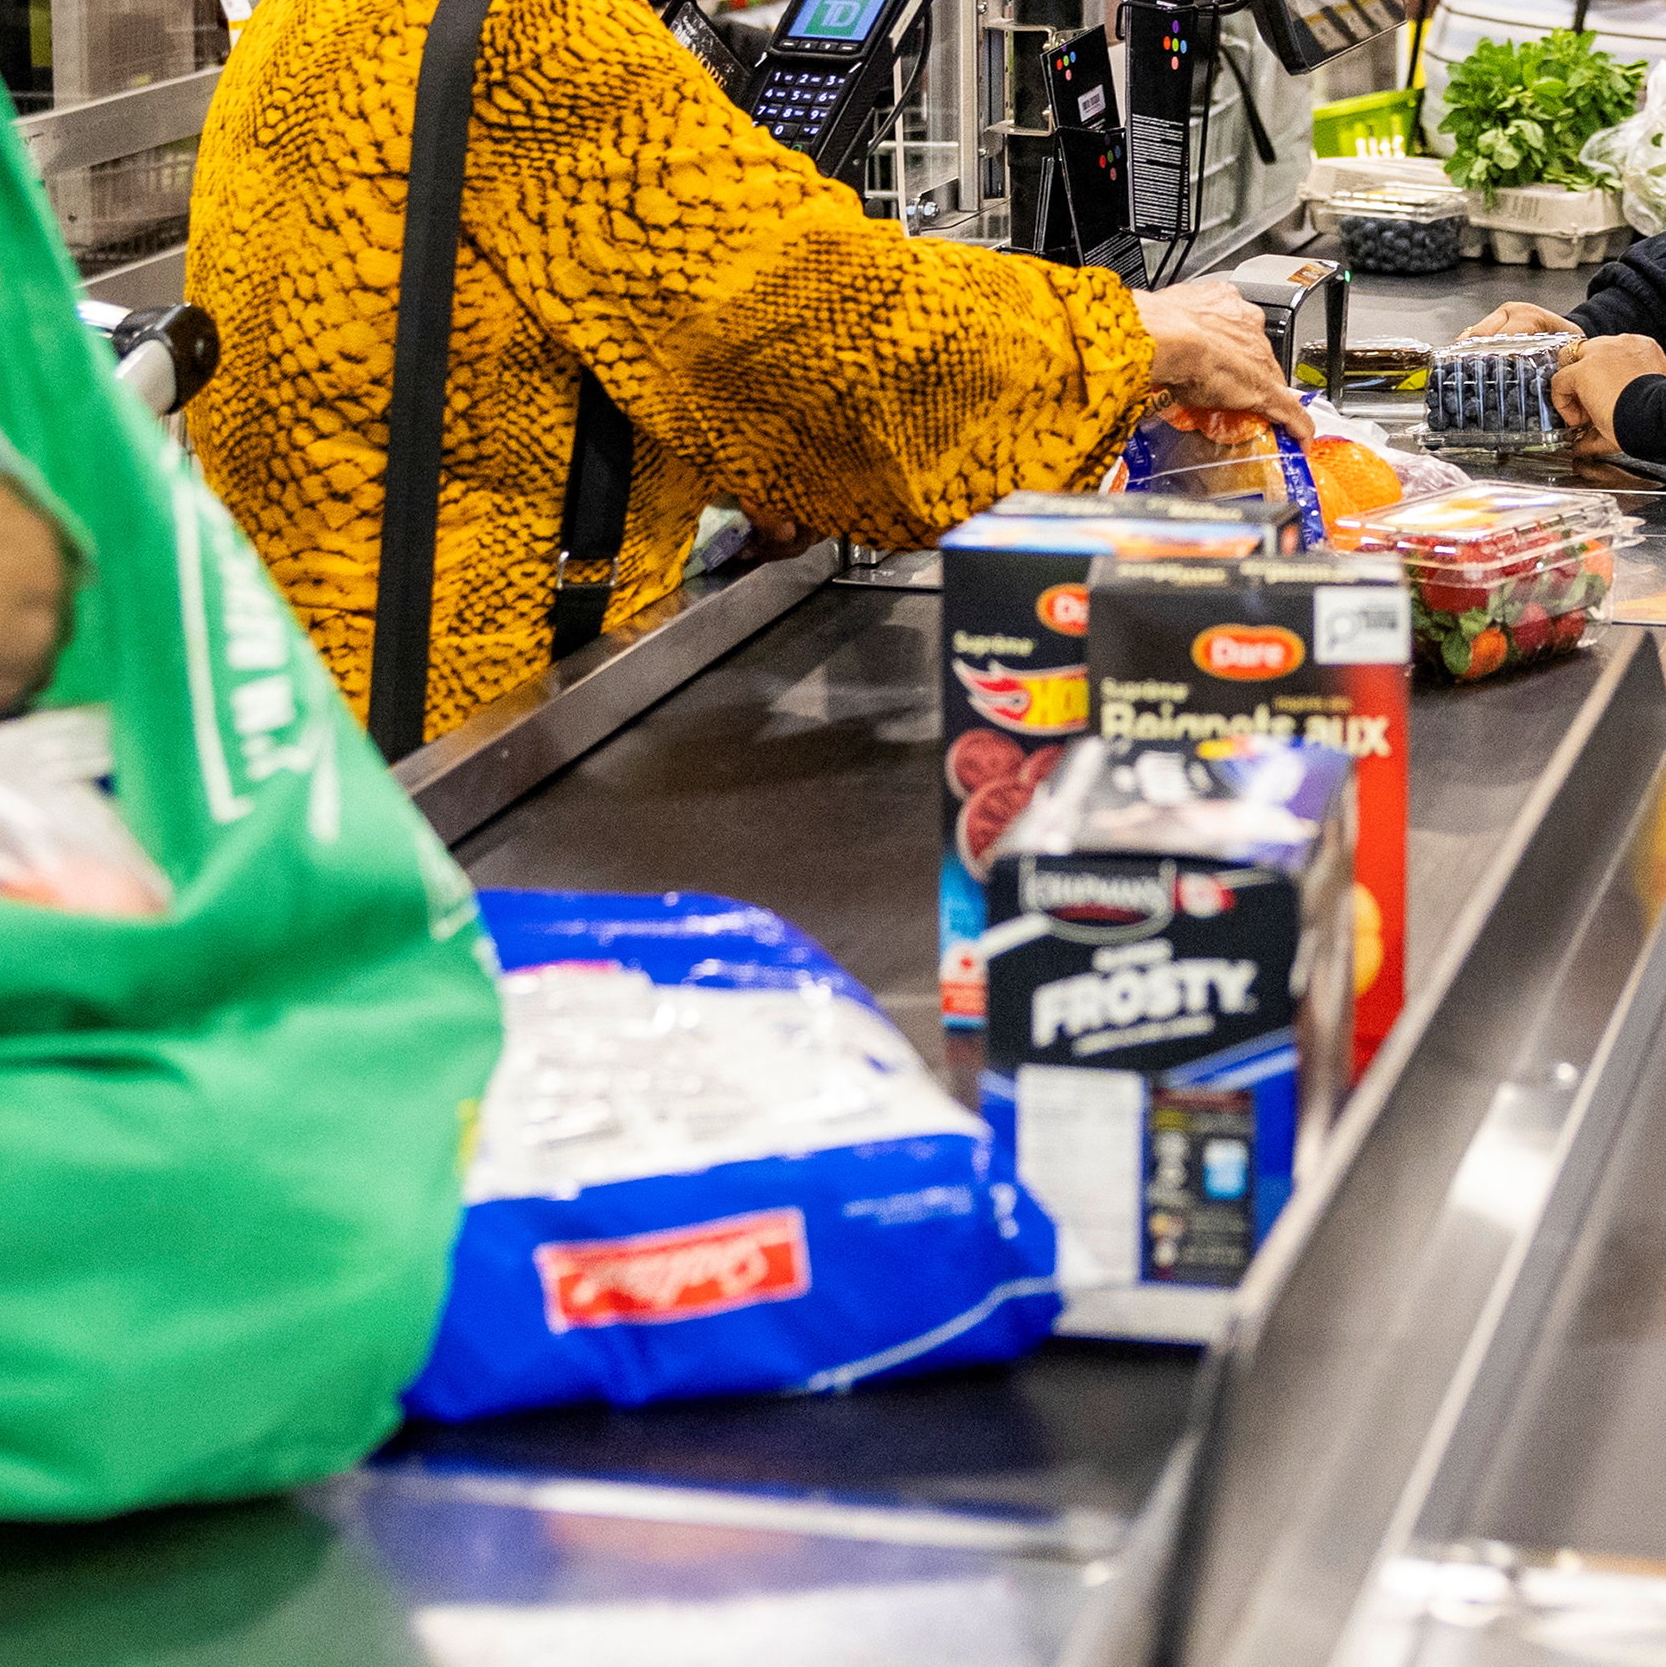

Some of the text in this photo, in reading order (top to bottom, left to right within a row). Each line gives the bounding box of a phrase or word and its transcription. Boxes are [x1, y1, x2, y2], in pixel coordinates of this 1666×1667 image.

[820, 0, 861, 28] TD
[1208, 636, 1285, 669] Dare
[1030, 957, 1248, 1049] FROSTY
